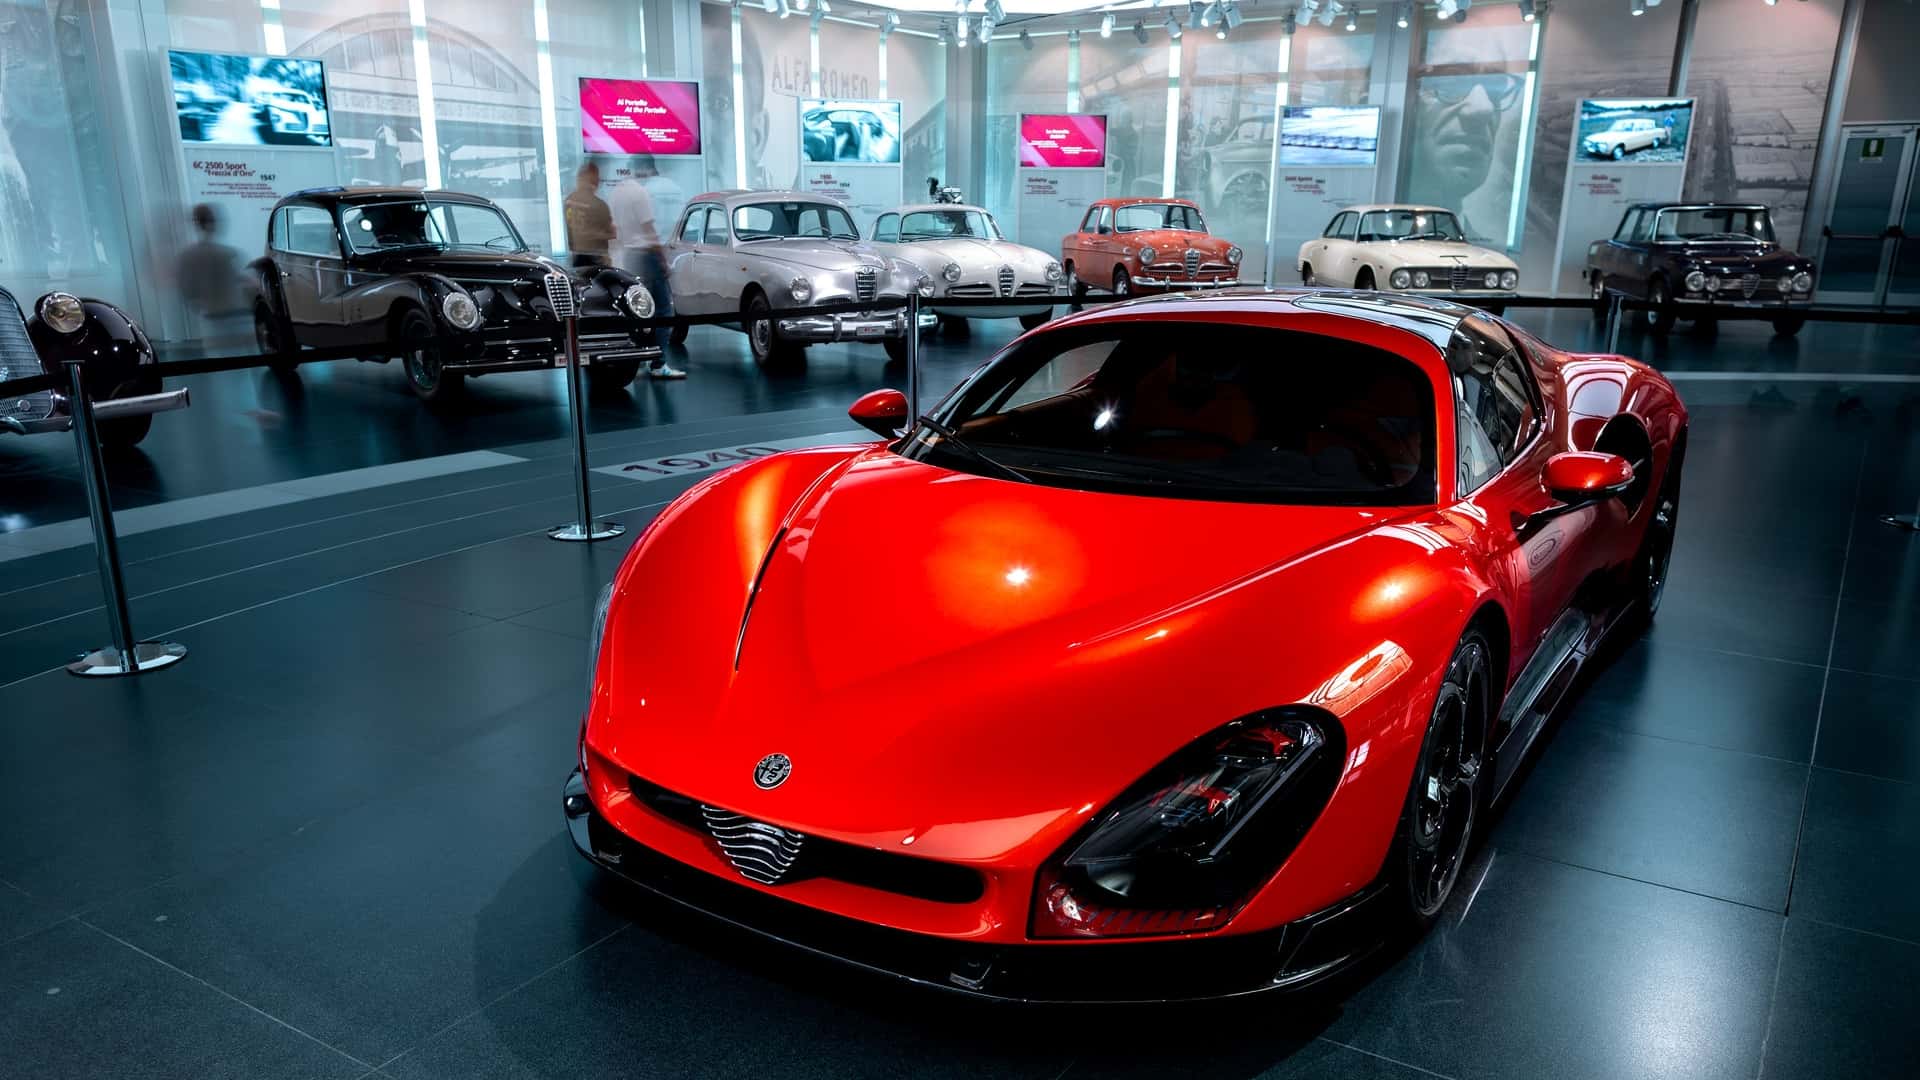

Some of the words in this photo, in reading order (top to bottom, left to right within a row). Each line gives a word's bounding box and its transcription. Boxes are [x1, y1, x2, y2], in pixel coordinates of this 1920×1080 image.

[772, 55, 812, 95] ALFA
[819, 66, 869, 99] ROMEO
[193, 161, 203, 169] 6C
[205, 161, 224, 169] 2500
[225, 162, 247, 170] Sport
